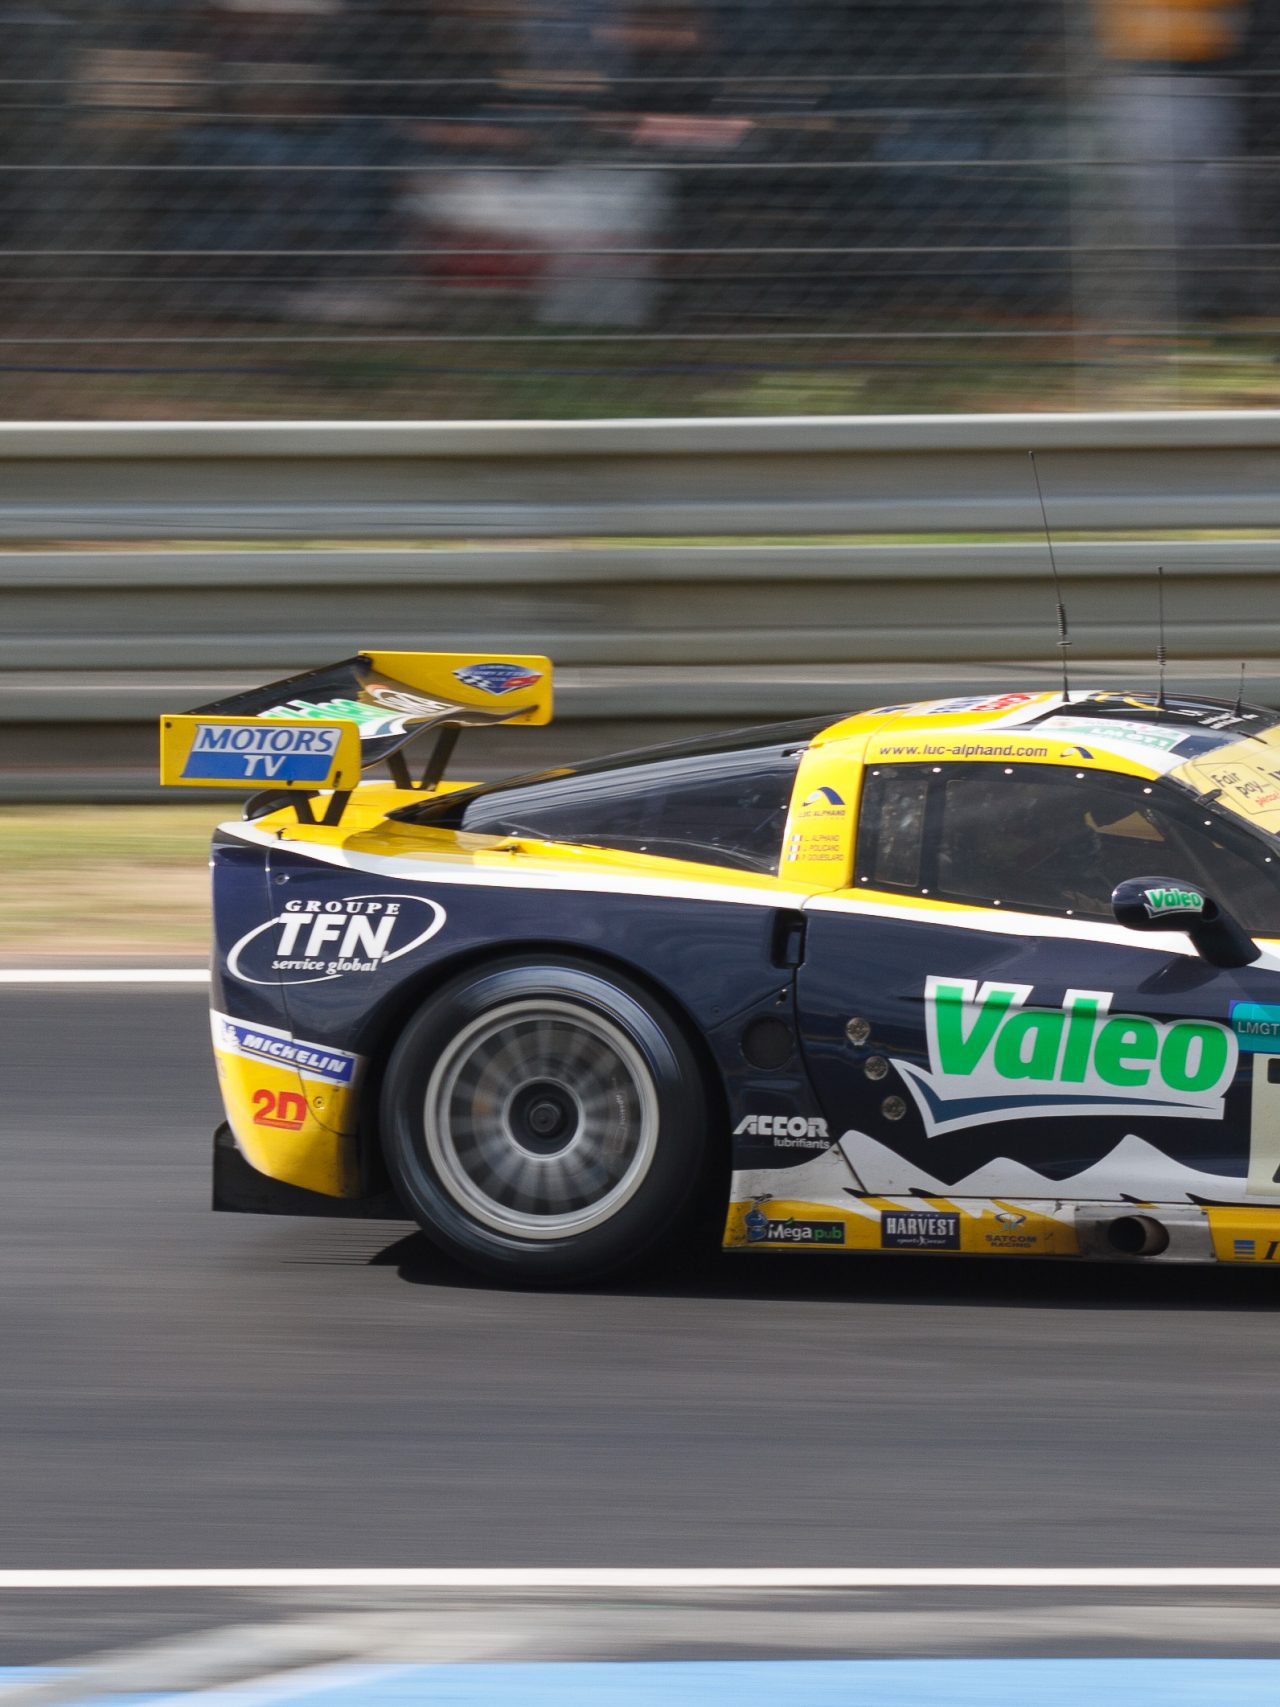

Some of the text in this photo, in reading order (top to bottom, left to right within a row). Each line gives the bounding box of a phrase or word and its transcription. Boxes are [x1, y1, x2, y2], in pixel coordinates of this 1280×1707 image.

[198, 728, 334, 752] MOTORS
[880, 744, 1048, 758] www.luc-alphand.com
[243, 755, 286, 776] TV
[1211, 771, 1240, 788] Fair
[814, 809, 846, 817] ALPHAND
[285, 899, 401, 915] GROUPE
[1150, 888, 1202, 908] Valeo
[276, 912, 397, 959] TFN
[271, 957, 378, 974] service global
[934, 983, 1229, 1093] Valeo
[243, 1034, 347, 1073] MICHELIN
[732, 1114, 830, 1138] ACCOR
[773, 1138, 831, 1150] lubrifiants
[814, 1226, 842, 1241] pub
[886, 1217, 957, 1237] HARVEST
[984, 1234, 1037, 1244] SATCOM
